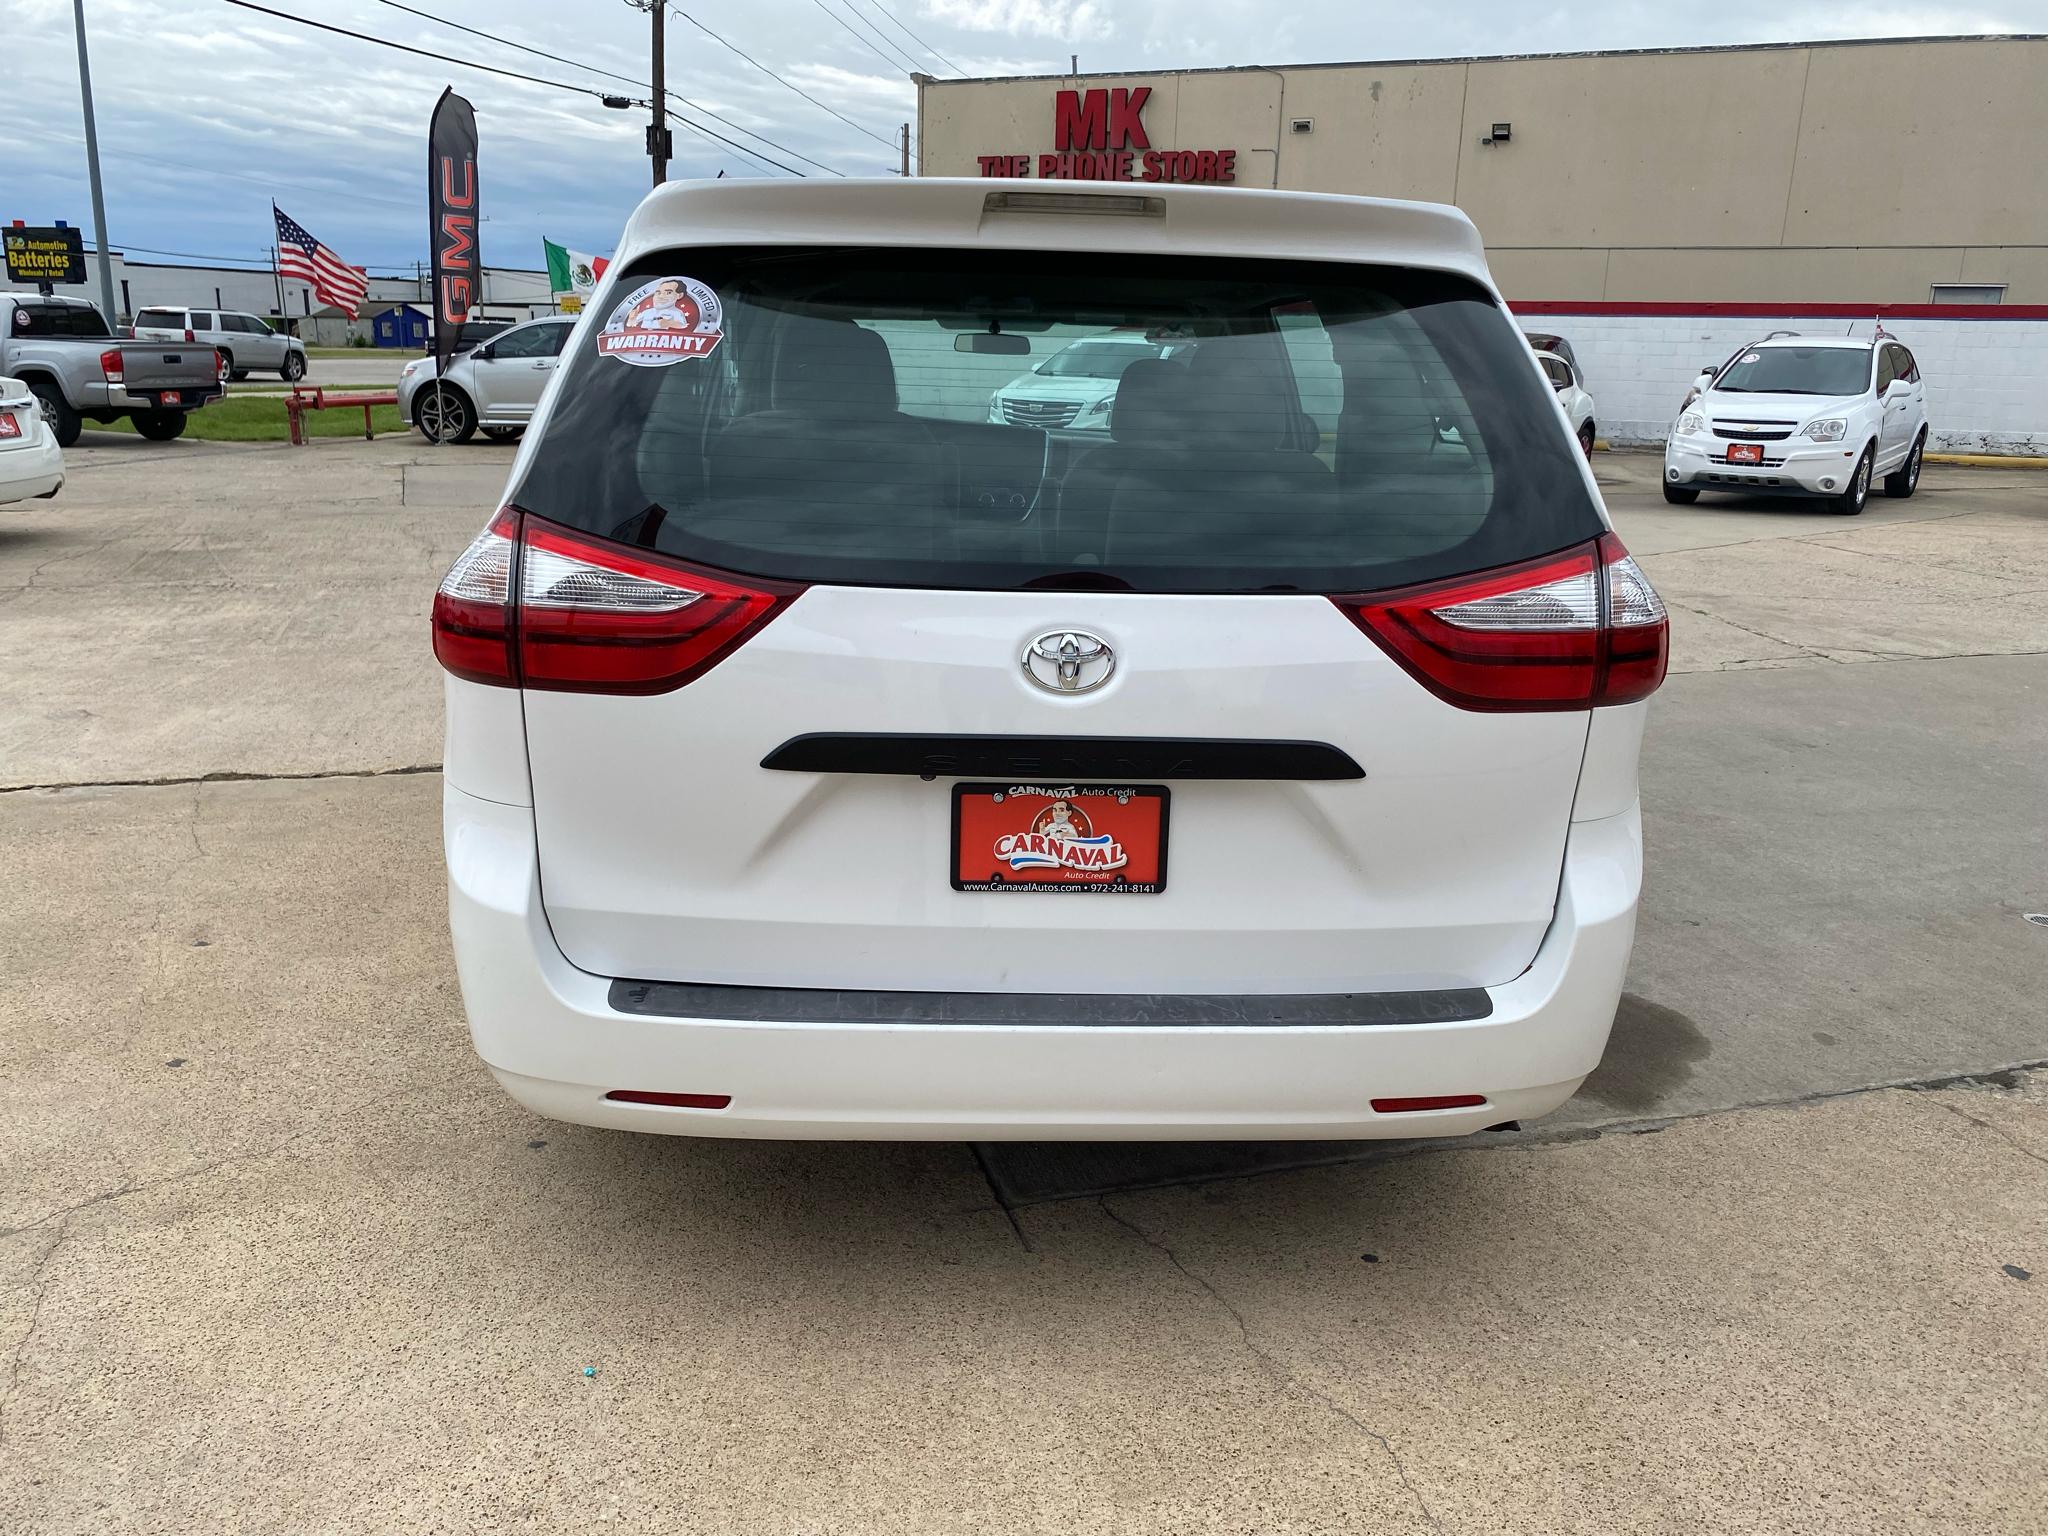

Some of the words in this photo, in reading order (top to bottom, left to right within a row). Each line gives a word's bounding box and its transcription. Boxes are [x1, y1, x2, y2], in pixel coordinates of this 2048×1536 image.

[1055, 87, 1152, 151] MK
[977, 155, 1030, 179] THE
[1039, 152, 1134, 181] PHONE
[1142, 150, 1236, 182] STORE
[27, 240, 68, 250] Automotive
[441, 157, 474, 324] GMC
[8, 251, 69, 267] Batteries
[628, 288, 649, 305] FREE
[691, 287, 715, 311] LIMITED
[607, 335, 706, 350] WARRANTY
[925, 755, 1193, 773] SENNA
[1008, 786, 1078, 799] CARNAVAL
[1082, 788, 1105, 796] Auto
[1107, 787, 1137, 797] Credit
[994, 833, 1126, 868] CARNAVAL
[1064, 872, 1085, 880] Auto
[1085, 872, 1110, 880] Credit
[963, 882, 1081, 892] www.CarnavalAutos.com
[1091, 884, 1155, 893] 972-241-8141
